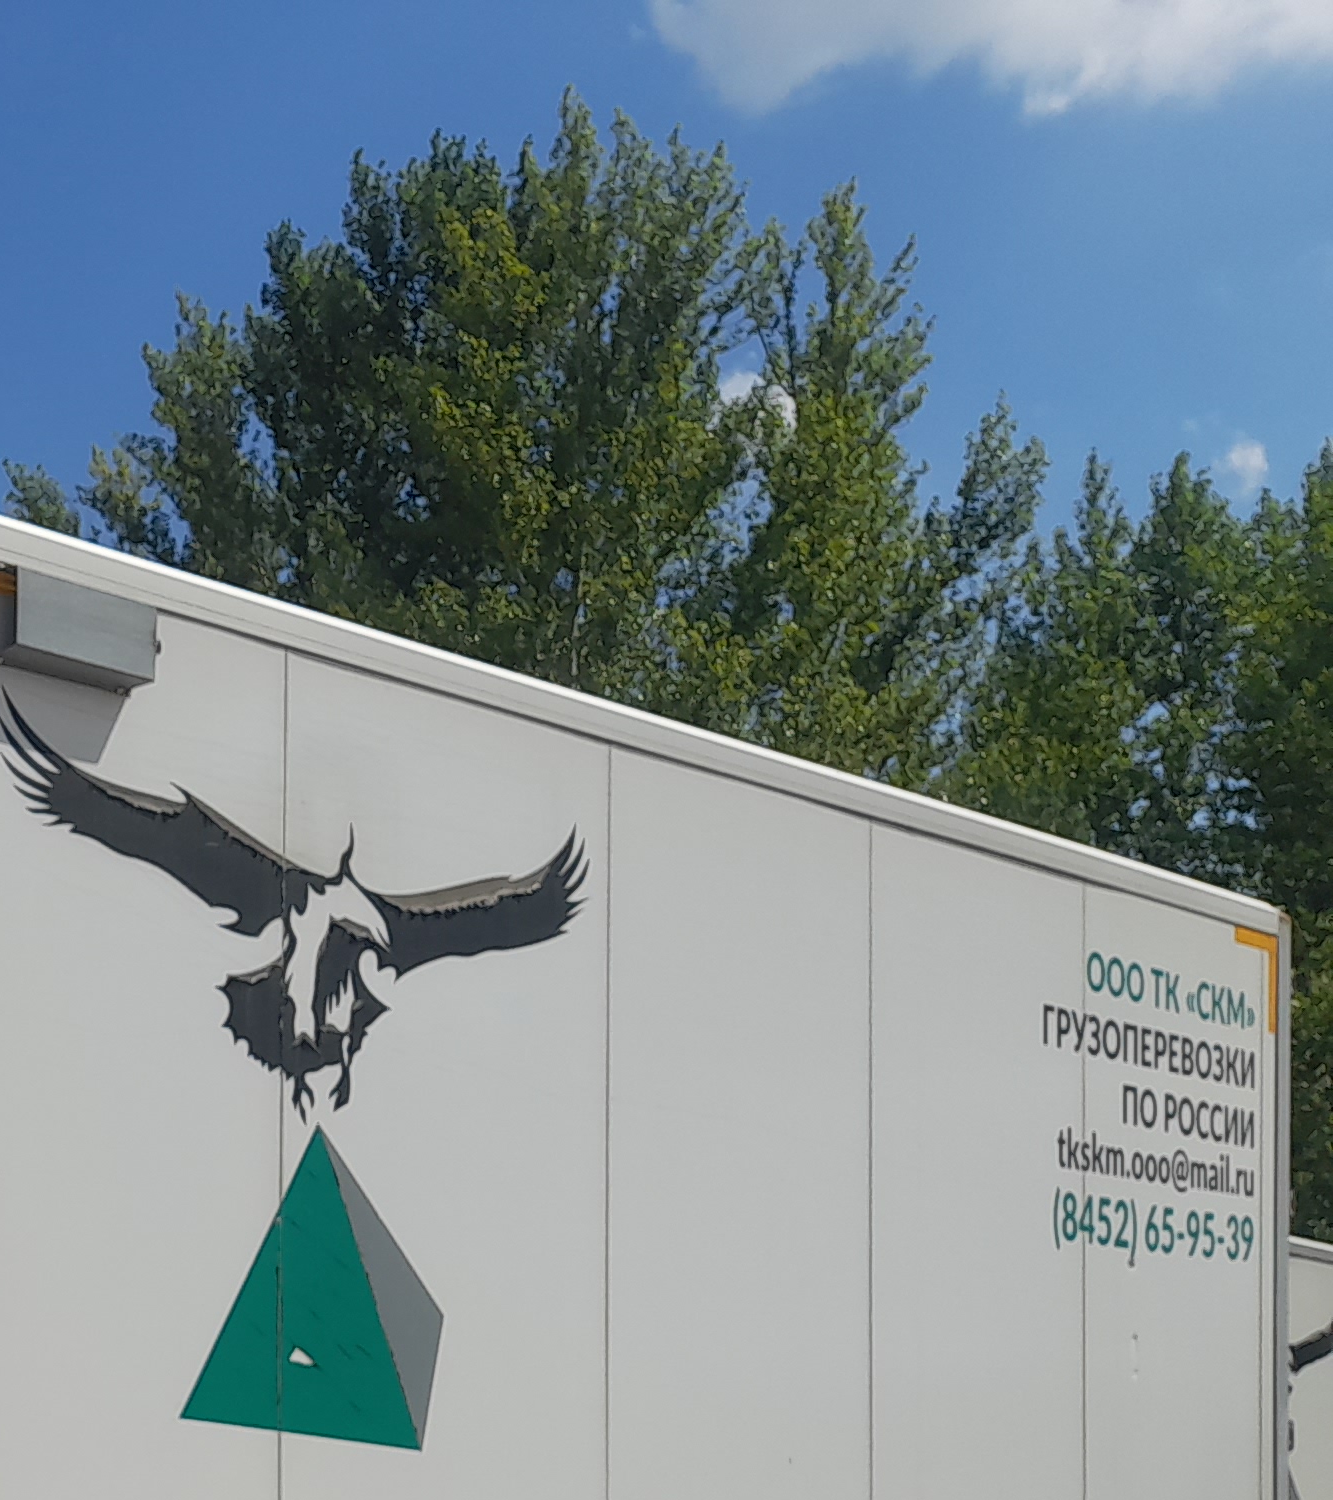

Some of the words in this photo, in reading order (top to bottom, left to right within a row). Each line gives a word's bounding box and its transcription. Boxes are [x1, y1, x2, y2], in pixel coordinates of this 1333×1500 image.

[1086, 951, 1145, 1003] ООО
[1150, 967, 1181, 1014] ТК
[1186, 981, 1256, 1029] «СКМ»
[1042, 1004, 1256, 1090] ГРУЗОПЕРЕВОЗКИ
[1122, 1084, 1158, 1129] ПО
[1164, 1092, 1255, 1150] РОССИИ
[1057, 1126, 1255, 1197] tkskm.ooo@mail.ru
[1053, 1187, 1138, 1257] (8452)
[1144, 1204, 1254, 1262] 65-95-39
